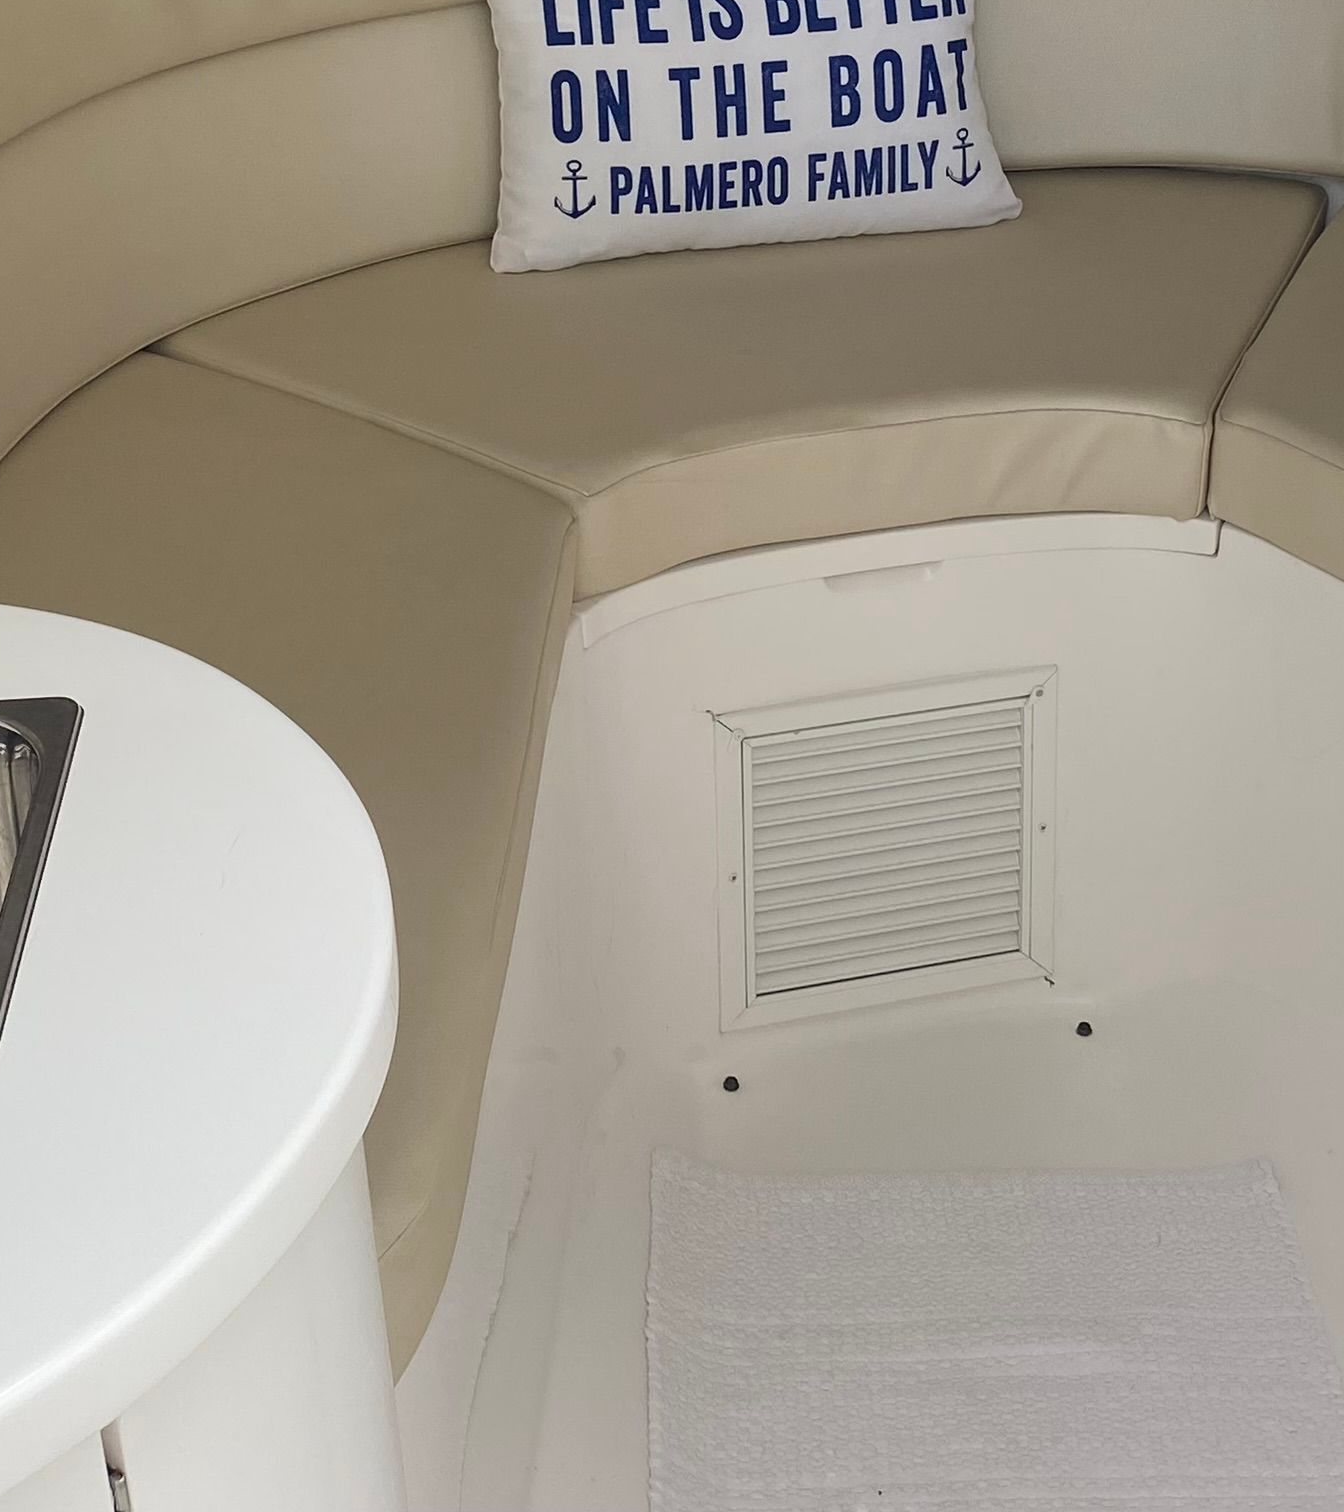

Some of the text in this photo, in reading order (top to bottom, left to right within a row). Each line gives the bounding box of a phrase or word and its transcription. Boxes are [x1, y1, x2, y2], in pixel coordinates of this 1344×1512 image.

[549, 38, 969, 144] ON THE BOAT
[609, 139, 941, 216] PALMERO FAMILY
